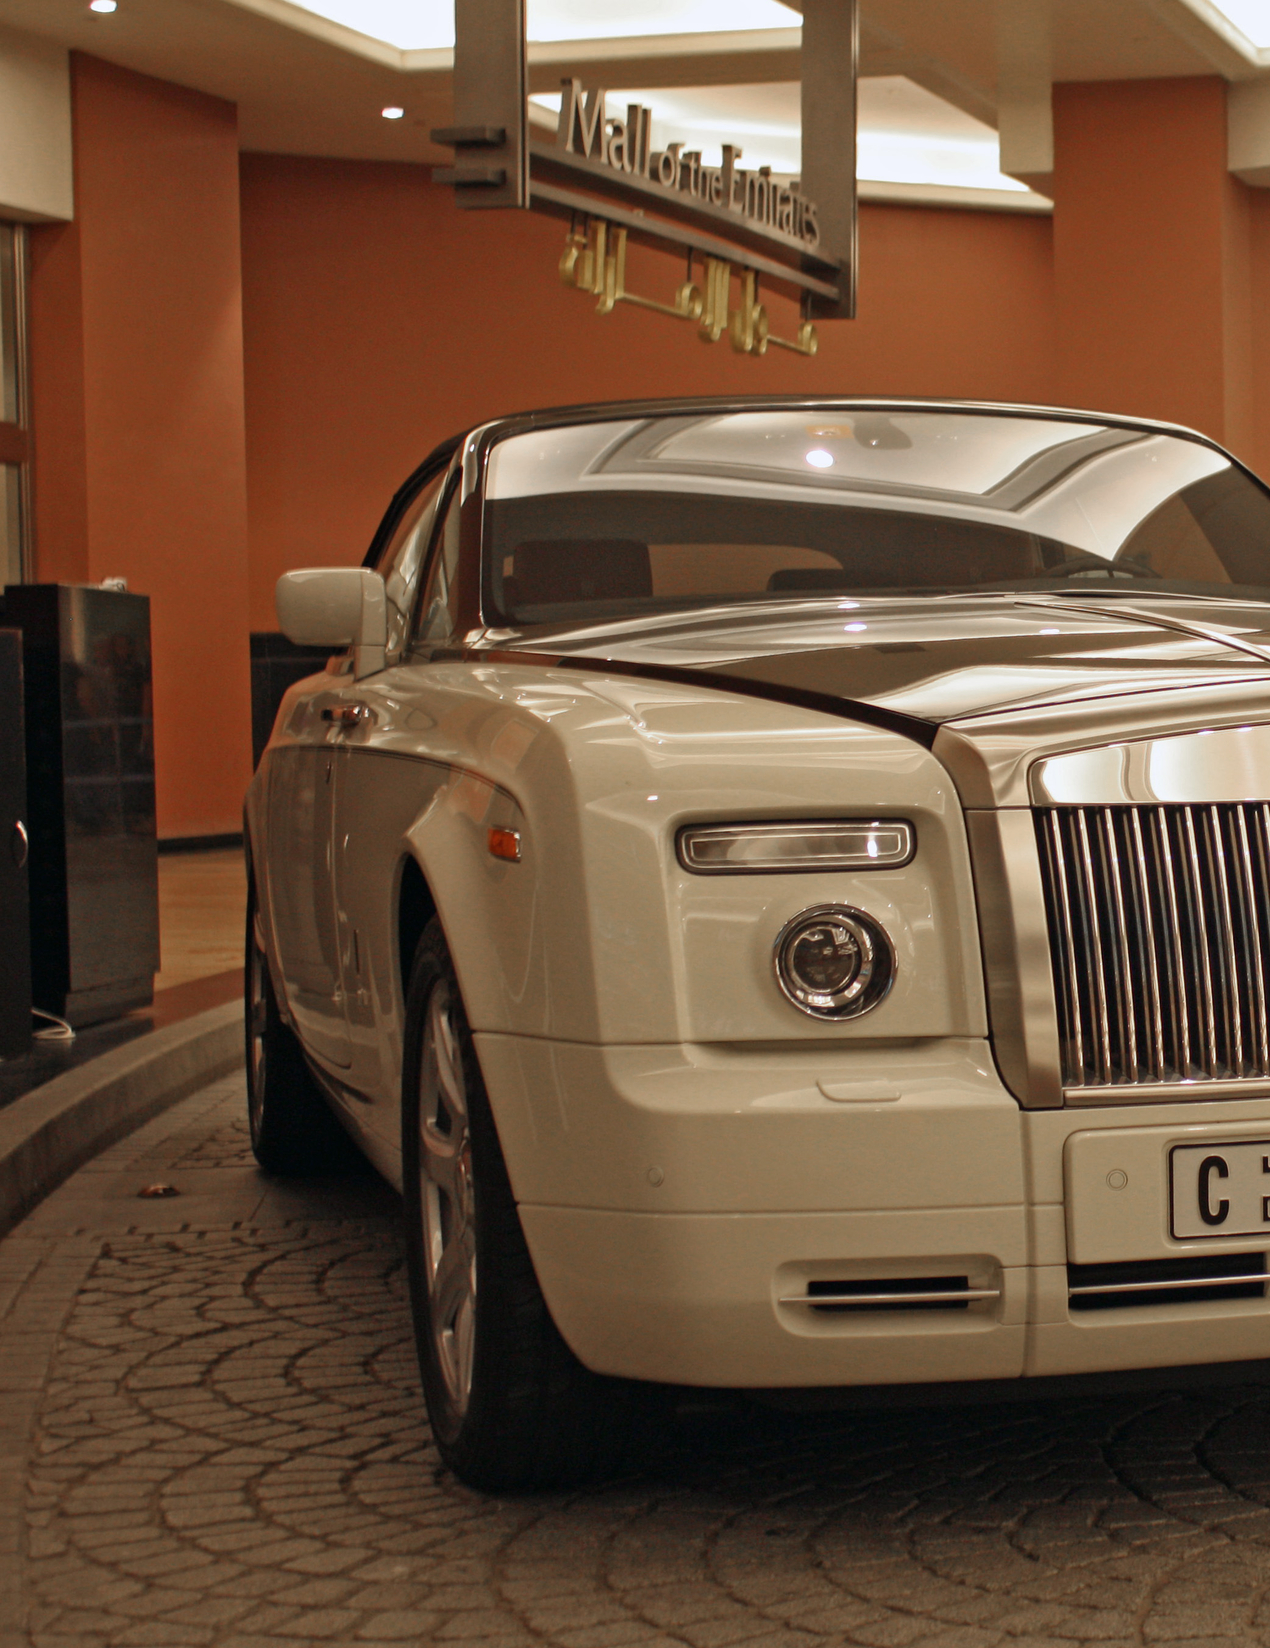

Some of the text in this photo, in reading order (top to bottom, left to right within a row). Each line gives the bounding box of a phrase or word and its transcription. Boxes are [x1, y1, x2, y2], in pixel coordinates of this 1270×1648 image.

[558, 78, 652, 180] Mall
[652, 143, 684, 190] of
[684, 150, 723, 206] the
[1198, 1155, 1230, 1226] C
